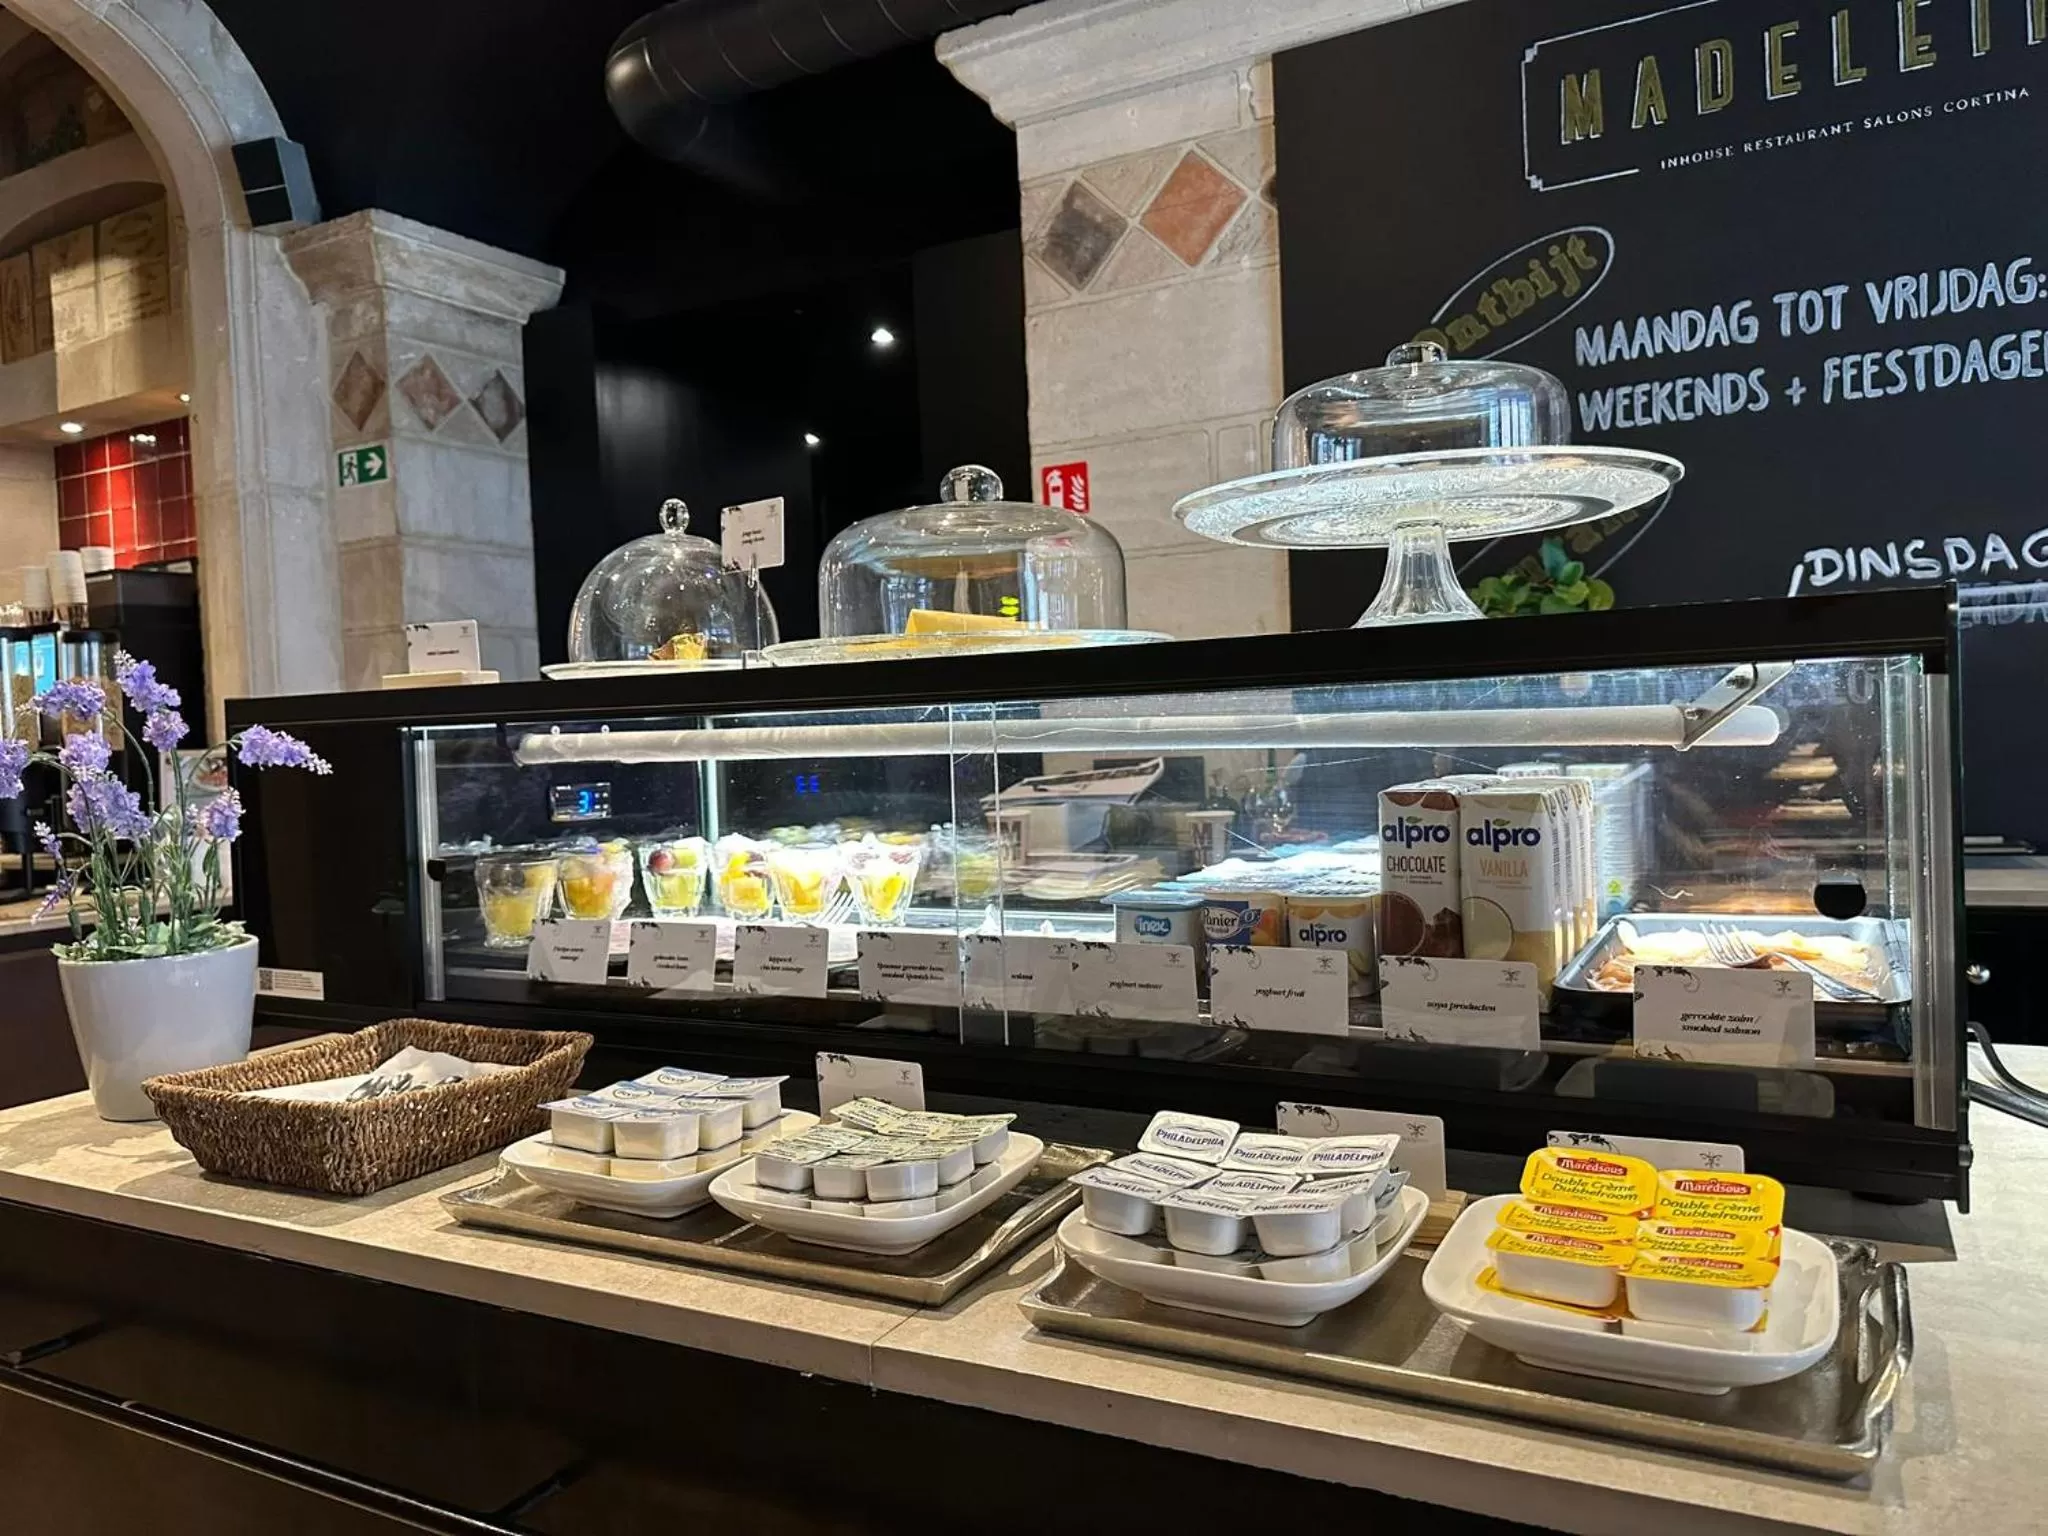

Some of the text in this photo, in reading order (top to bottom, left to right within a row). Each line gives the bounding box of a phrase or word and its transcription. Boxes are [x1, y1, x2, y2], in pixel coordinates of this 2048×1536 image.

[1660, 87, 2030, 170] INHOUSE RESTAURANT SALONS CORTINA
[1575, 257, 2048, 367] MAANDAG TOT VRIJDAG:
[1578, 367, 1769, 433] WEEKENDS
[1784, 376, 1807, 406] +
[1382, 816, 1450, 848] alpro
[1466, 819, 1541, 852] alpro
[1386, 855, 1446, 873] CHOCOLATE
[1479, 857, 1528, 878] VANILLA
[1299, 923, 1347, 947] alpro
[1109, 980, 1137, 990] yoghurt
[1254, 987, 1305, 998] yoghurt fruit
[1448, 1001, 1496, 1012] producten
[1680, 1011, 1726, 1022] gerookte
[1727, 1013, 1754, 1024] zalm
[1681, 1023, 1761, 1035] smoked salmon
[1156, 1128, 1225, 1147] PHILADELPHIA
[1234, 1149, 1303, 1163] PHILADELPHI
[1312, 1151, 1385, 1163] PHILADELPHIA
[1561, 1158, 1625, 1175] Maredsous
[1212, 1179, 1286, 1193] PHILADELPHIA
[1541, 1172, 1590, 1187] Double
[1591, 1180, 1636, 1192] Crème
[1680, 1180, 1747, 1194] Maredsous
[1552, 1183, 1638, 1200] Dubbelroom
[1539, 1205, 1603, 1221] Maredsous
[1660, 1198, 1761, 1213] Double Crème
[1672, 1208, 1763, 1221] Dubbelroom
[1663, 1226, 1732, 1239] Maredsous
[1531, 1234, 1599, 1250] Maredsous
